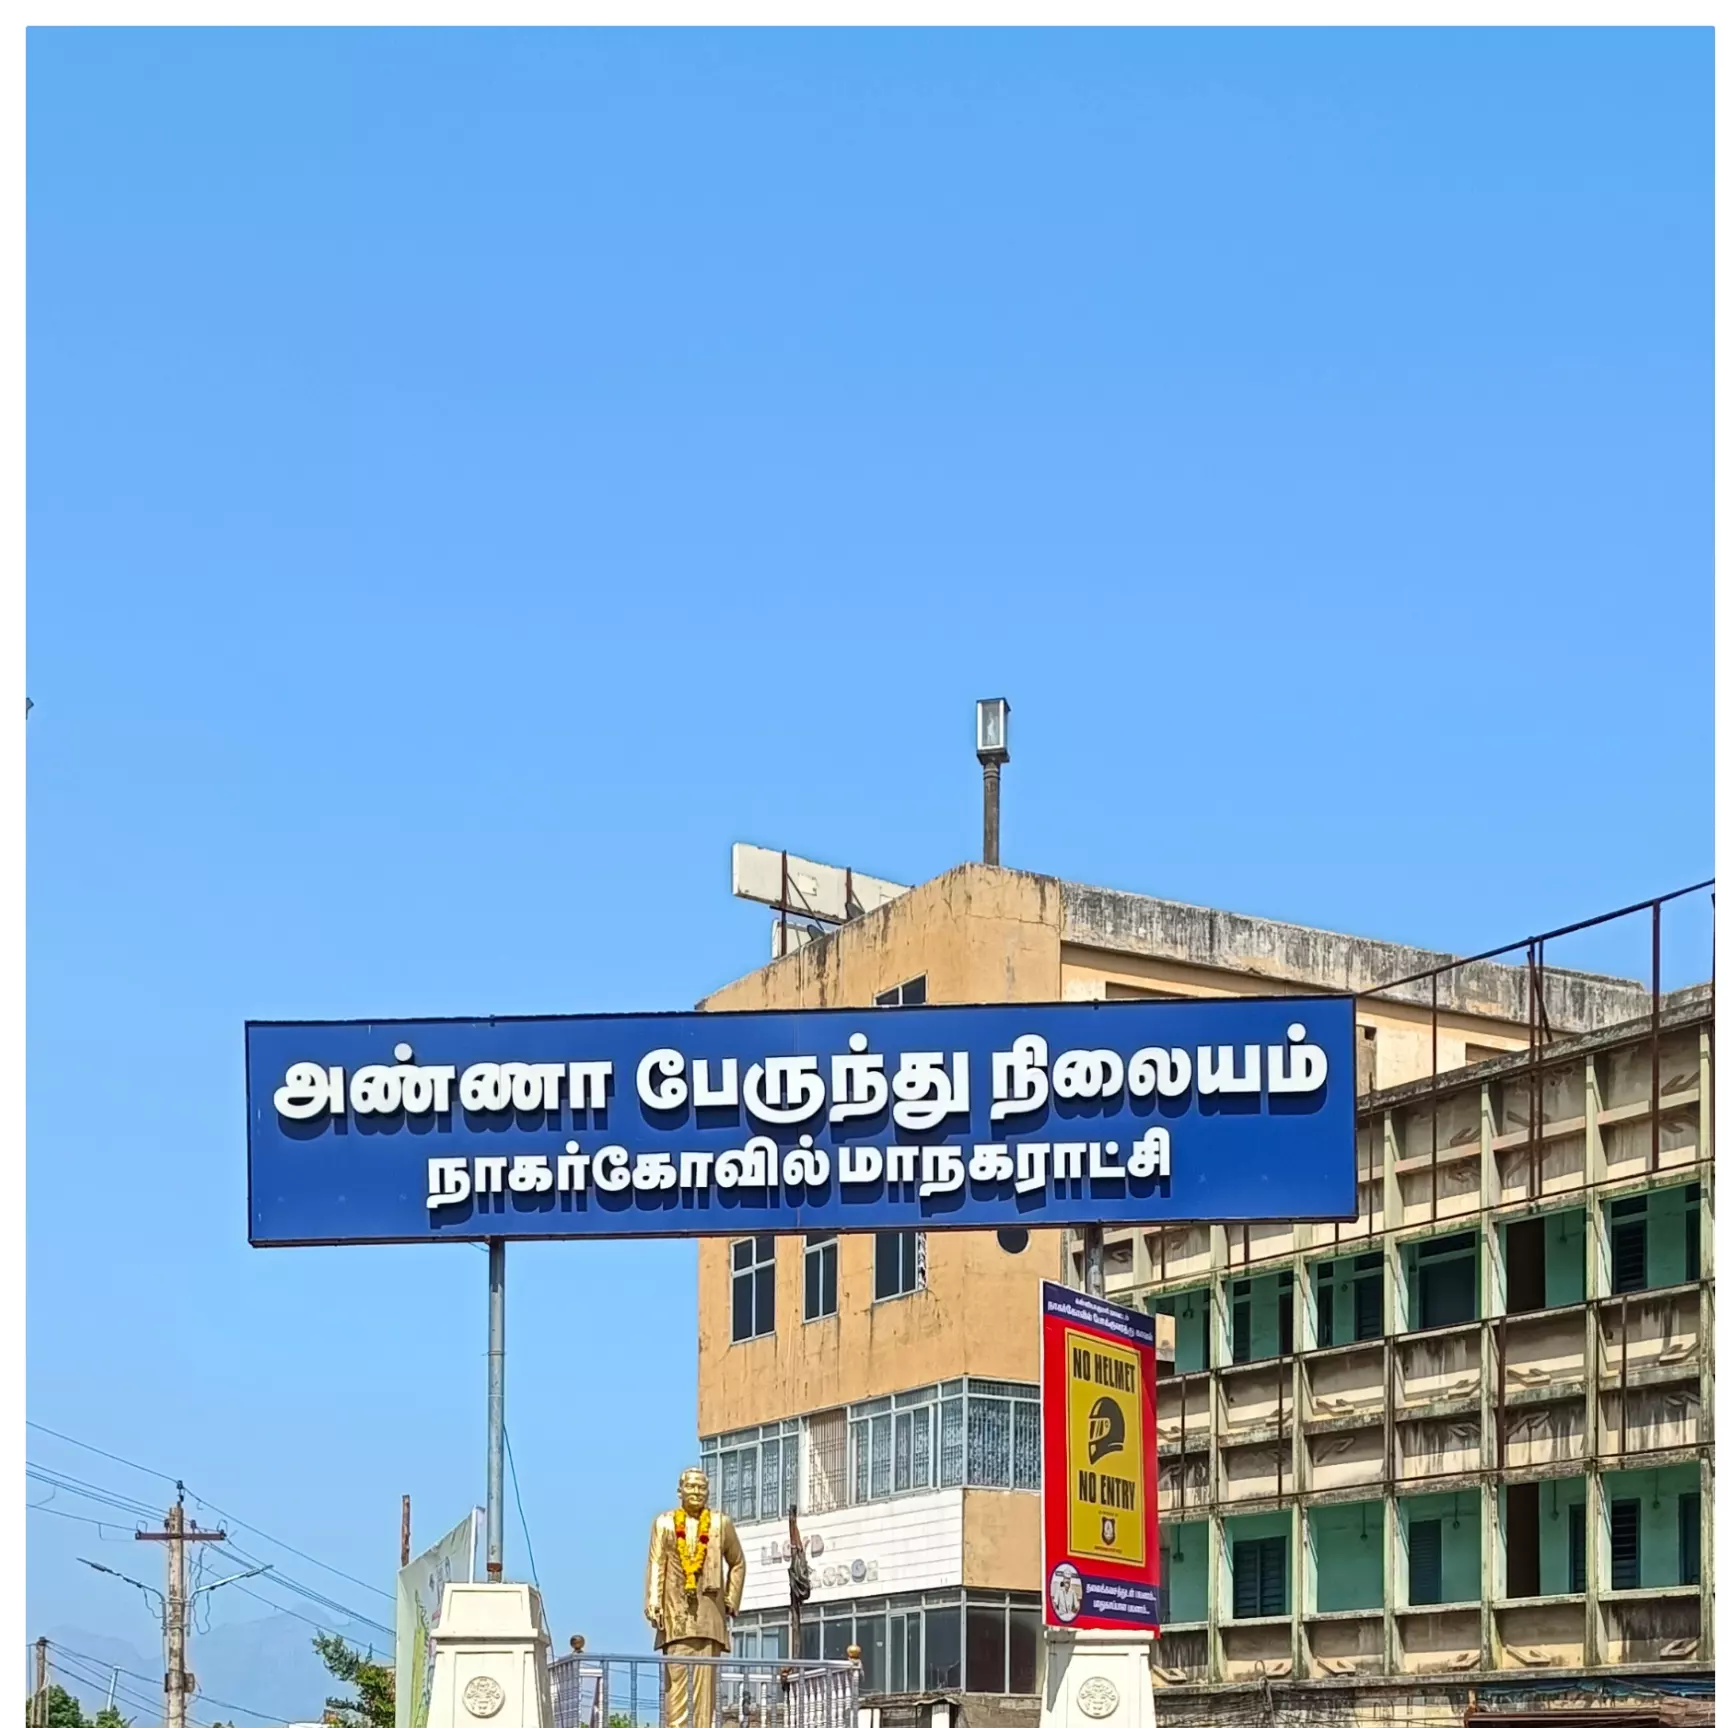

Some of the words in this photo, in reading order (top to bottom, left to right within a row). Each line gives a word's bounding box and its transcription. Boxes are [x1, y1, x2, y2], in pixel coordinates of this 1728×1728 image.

[273, 1042, 612, 1119] அண்ணா
[637, 1033, 970, 1131] பேருந்து
[989, 1023, 1329, 1117] நிலையம்
[426, 1134, 830, 1208] நாகர்கோவில்
[838, 1126, 1171, 1194] மாநகராட்சி
[1073, 1347, 1091, 1382] NO
[1094, 1353, 1136, 1394] HELMET
[1079, 1470, 1097, 1504] NO
[1100, 1474, 1136, 1511] ENTRY
